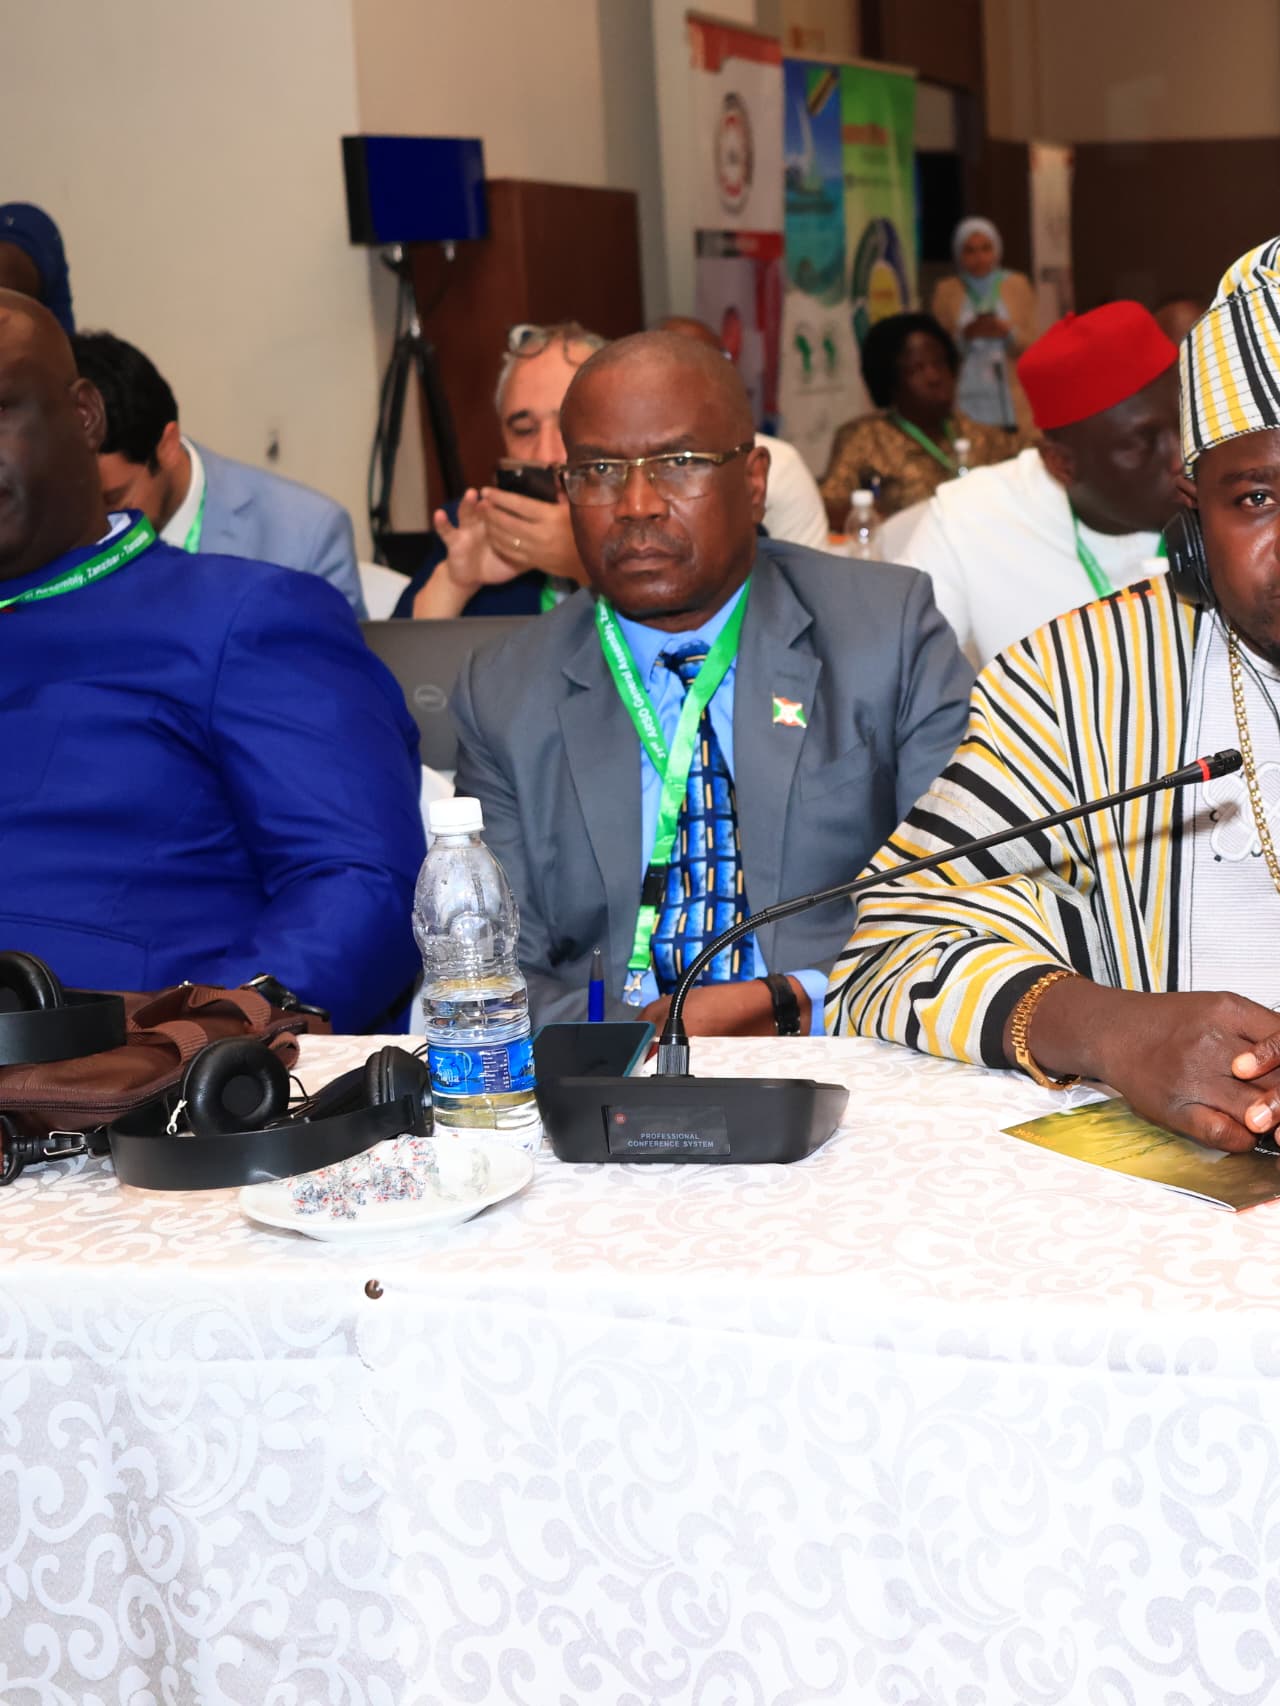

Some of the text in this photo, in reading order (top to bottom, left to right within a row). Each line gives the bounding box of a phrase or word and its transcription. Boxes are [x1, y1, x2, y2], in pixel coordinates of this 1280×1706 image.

[621, 670, 645, 709] General
[637, 707, 658, 739] ARSO
[627, 1140, 714, 1148] CONFERENCE SYSTEM
[640, 1132, 700, 1140] PROFESSIONAL
